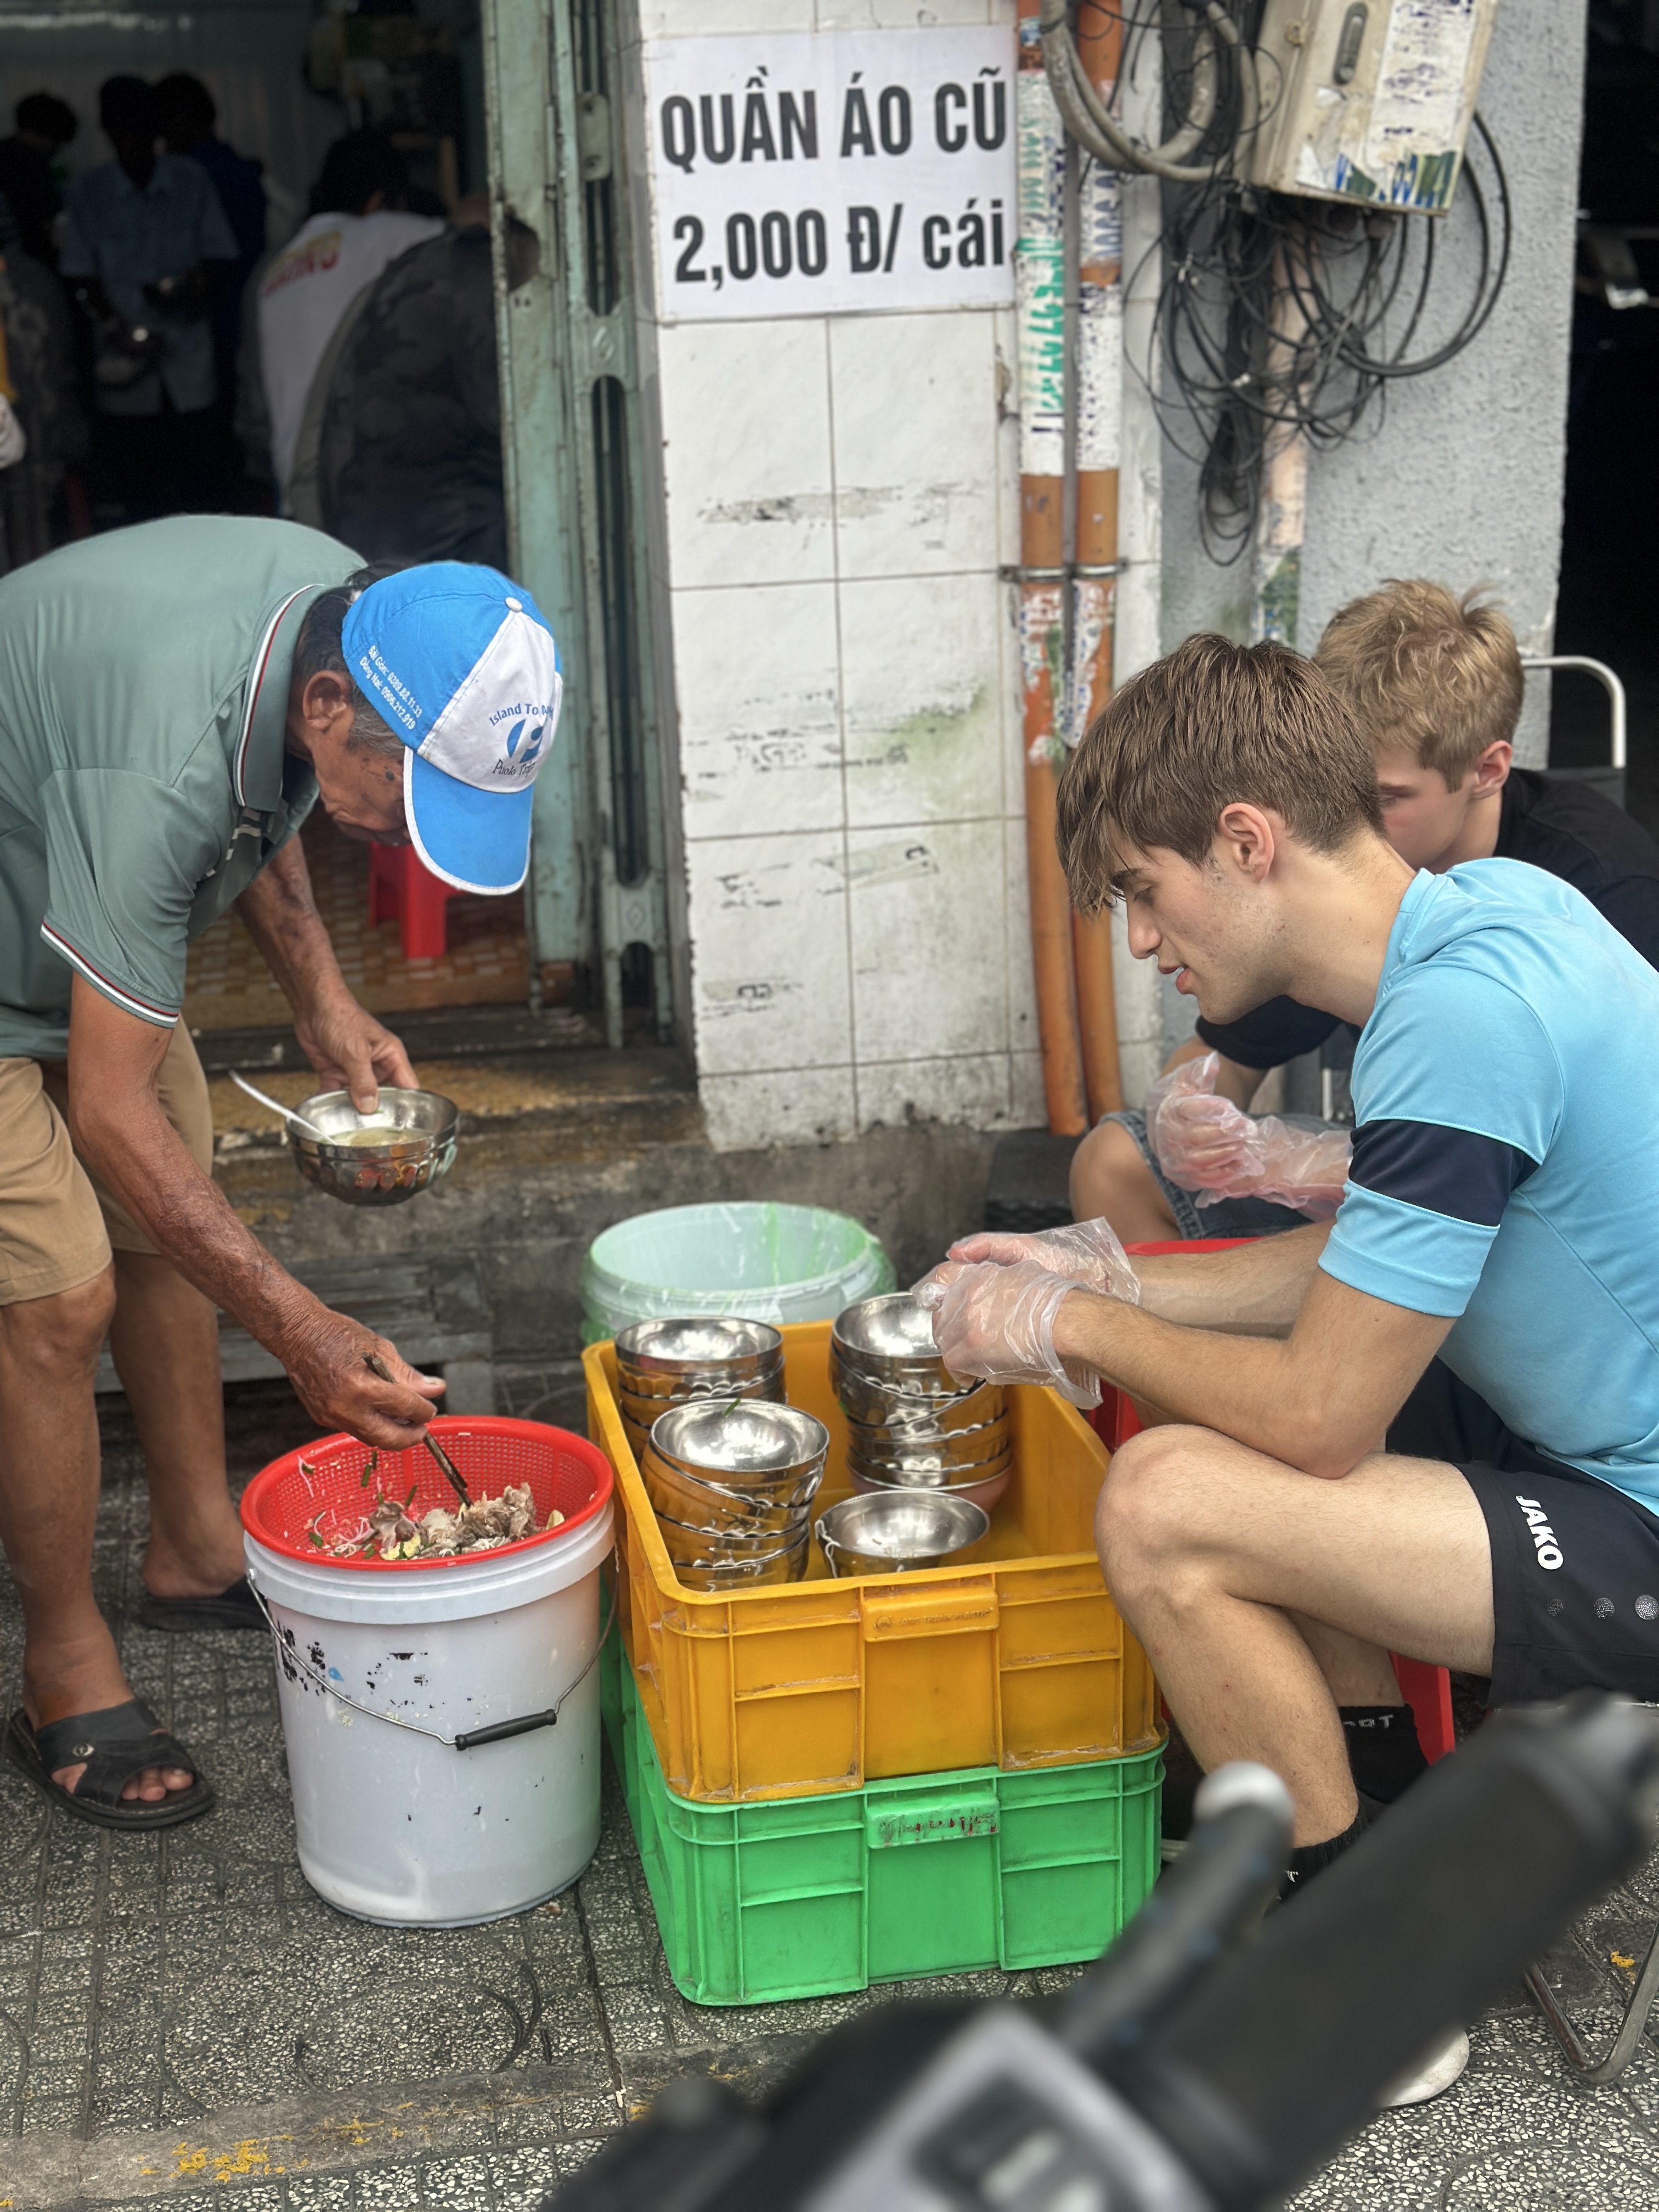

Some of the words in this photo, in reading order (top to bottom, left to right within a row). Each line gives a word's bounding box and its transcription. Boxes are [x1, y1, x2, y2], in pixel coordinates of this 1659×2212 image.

[661, 66, 819, 174] QUẦN
[840, 72, 912, 158] ÁO
[935, 66, 1006, 153] CŨ
[673, 209, 827, 291] 2,000
[846, 203, 904, 273] Đ/
[923, 198, 1004, 270] cái
[489, 703, 521, 726] Island
[525, 703, 539, 715] To
[1516, 1496, 1564, 1570] JAKO
